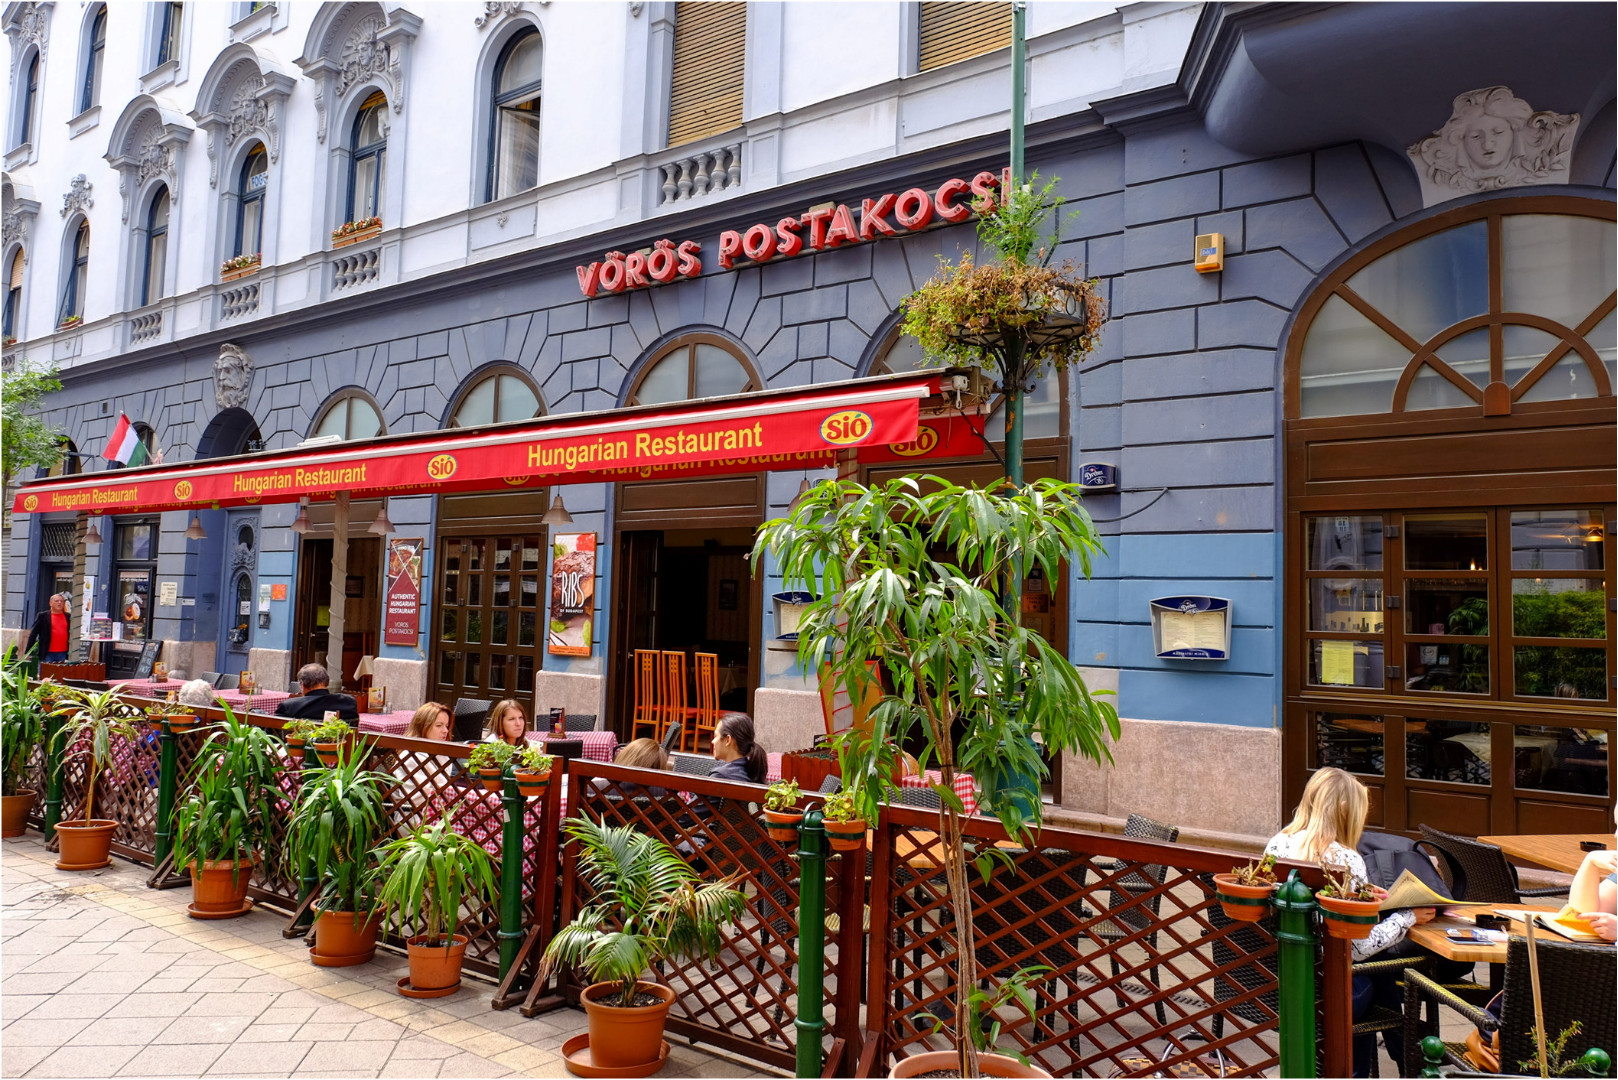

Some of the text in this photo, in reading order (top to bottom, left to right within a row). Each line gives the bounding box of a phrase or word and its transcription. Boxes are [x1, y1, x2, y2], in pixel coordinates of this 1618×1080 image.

[576, 166, 1012, 298] VÖRÖS POSTAKOCSI
[826, 413, 867, 441] Sió
[527, 421, 763, 470] Hungarian Restaurant
[233, 470, 292, 495] Hungarian
[295, 463, 367, 488] Restaurant
[51, 485, 138, 509] Hungarian Restaurant
[561, 570, 585, 608] RIBS
